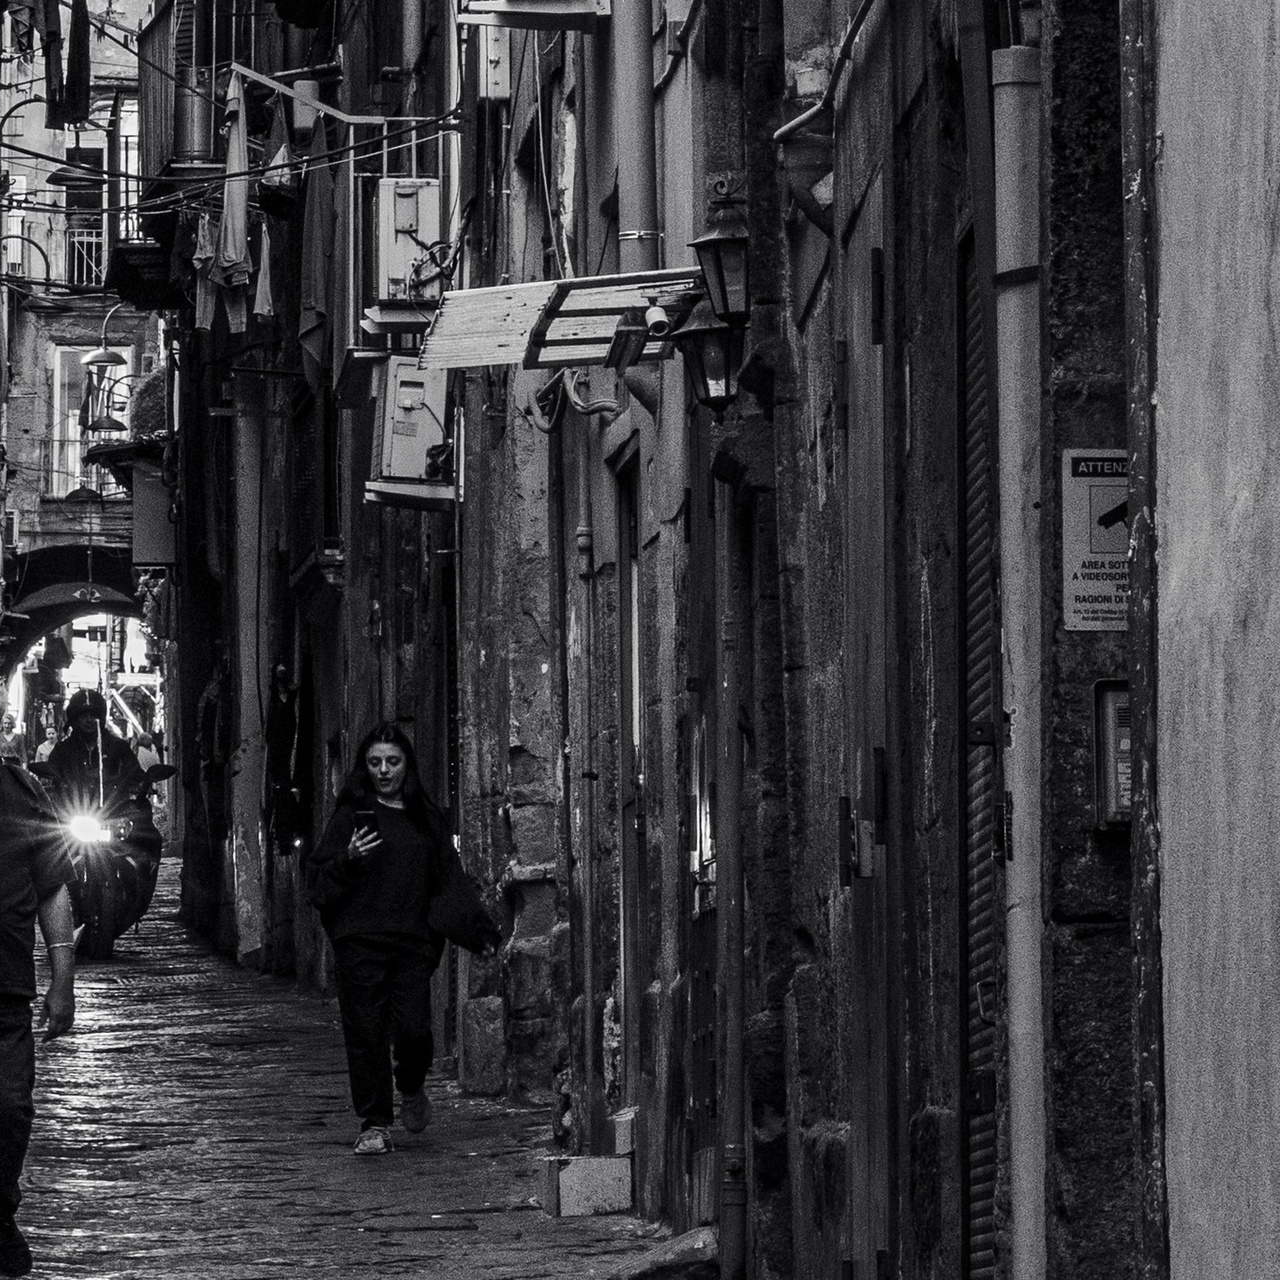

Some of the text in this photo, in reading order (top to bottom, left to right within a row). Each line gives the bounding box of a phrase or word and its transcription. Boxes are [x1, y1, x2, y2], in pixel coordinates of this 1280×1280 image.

[1081, 561, 1106, 569] AREA
[1072, 572, 1079, 581] A
[1075, 595, 1112, 604] RAGIONI
[1115, 595, 1124, 604] DI
